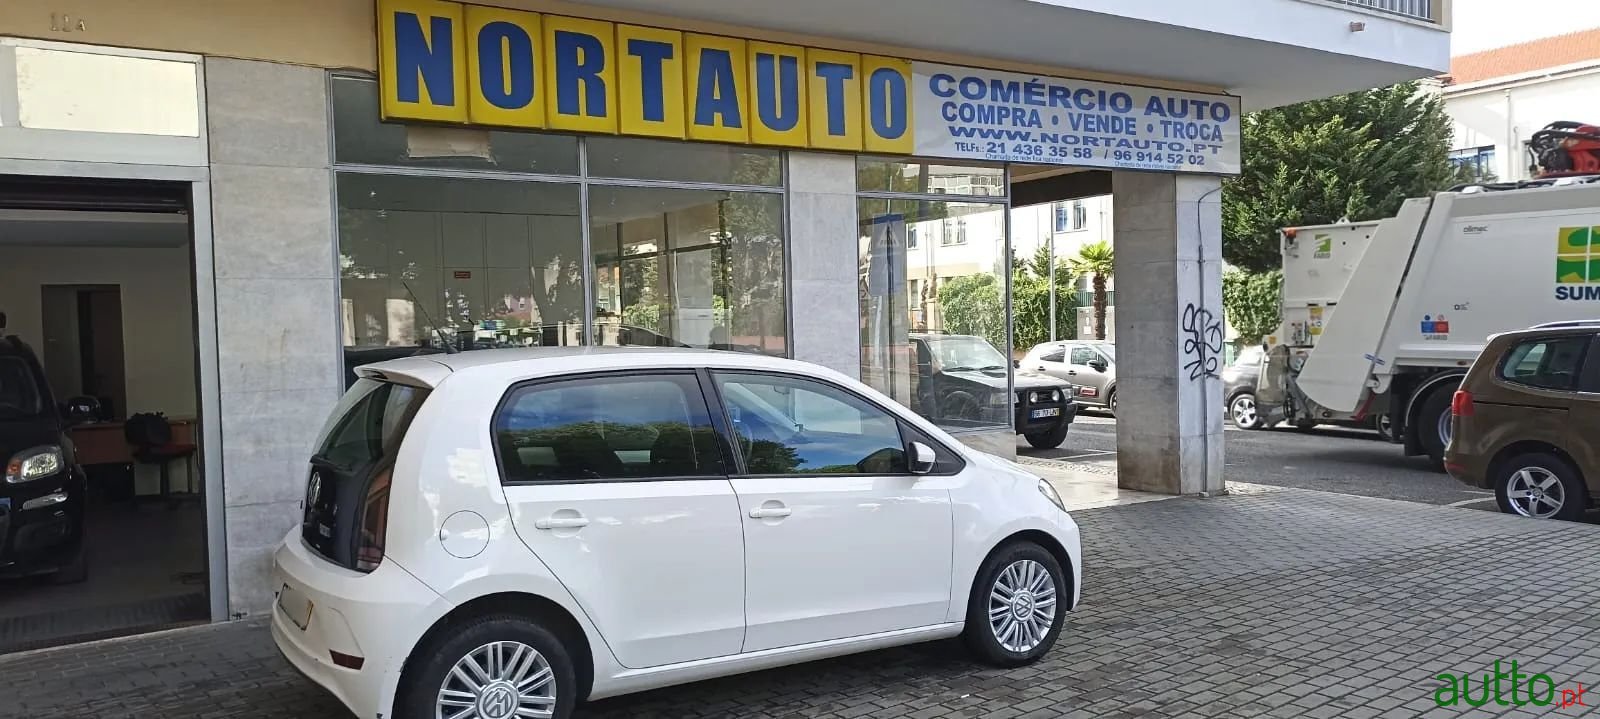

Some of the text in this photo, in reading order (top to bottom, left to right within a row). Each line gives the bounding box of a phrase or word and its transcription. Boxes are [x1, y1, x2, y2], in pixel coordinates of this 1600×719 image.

[397, 14, 906, 138] NORTAUTO
[929, 73, 1231, 122] COMÉRCIO AUTO
[942, 101, 1223, 142] COMPRA VENDE TROCA
[948, 125, 1223, 154] WWW.NORTAUTO.PT
[986, 142, 1006, 153] 21
[1012, 144, 1043, 156] 436
[1049, 146, 1068, 157] 35
[1073, 147, 1092, 158] 58
[1113, 152, 1131, 161] 96
[1136, 152, 1163, 162] 914
[1167, 154, 1184, 164] 52
[1188, 155, 1205, 166] 02
